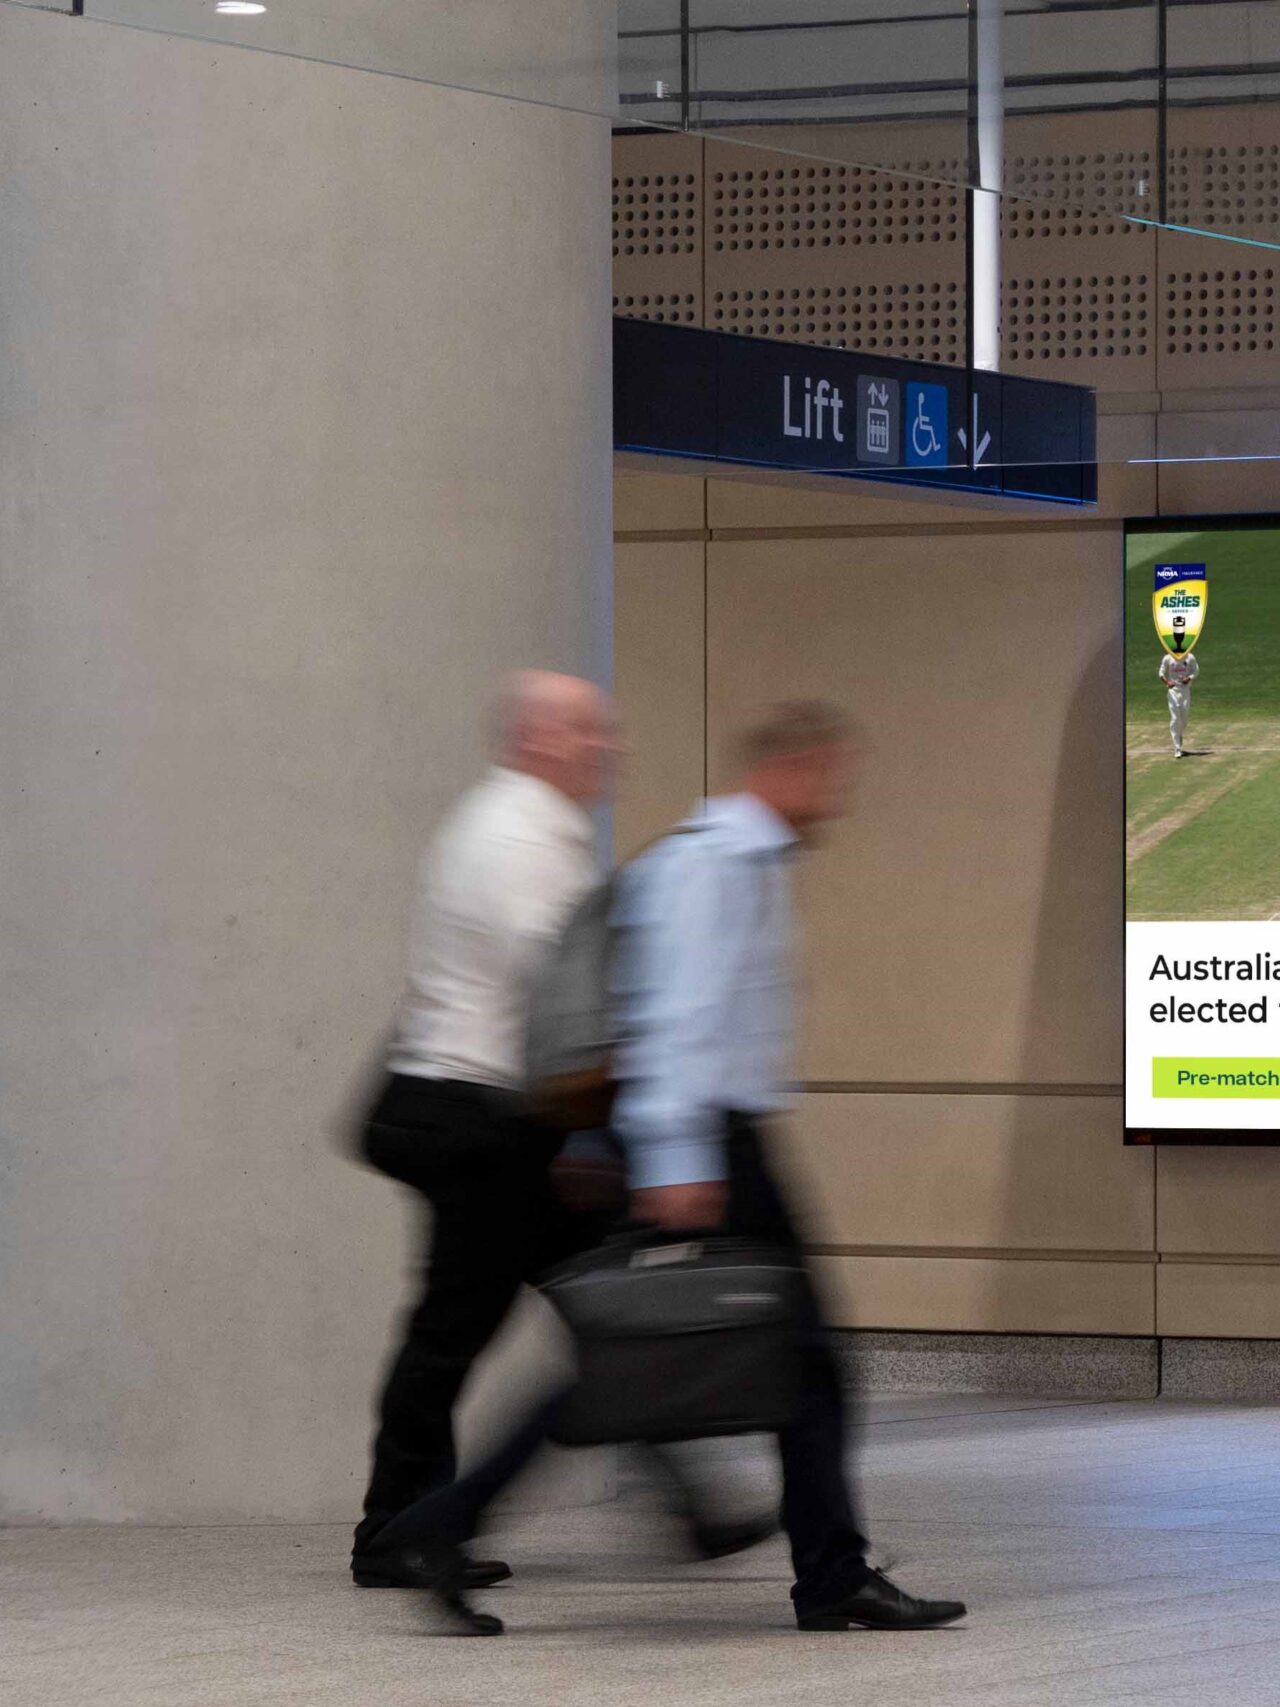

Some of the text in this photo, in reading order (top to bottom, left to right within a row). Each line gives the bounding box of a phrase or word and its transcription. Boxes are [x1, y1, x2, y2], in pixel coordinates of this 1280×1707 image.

[783, 375, 844, 442] Lift
[1160, 596, 1200, 608] ASHES
[1149, 995, 1267, 1024] elected
[1177, 1070, 1280, 1087] Pre-match
